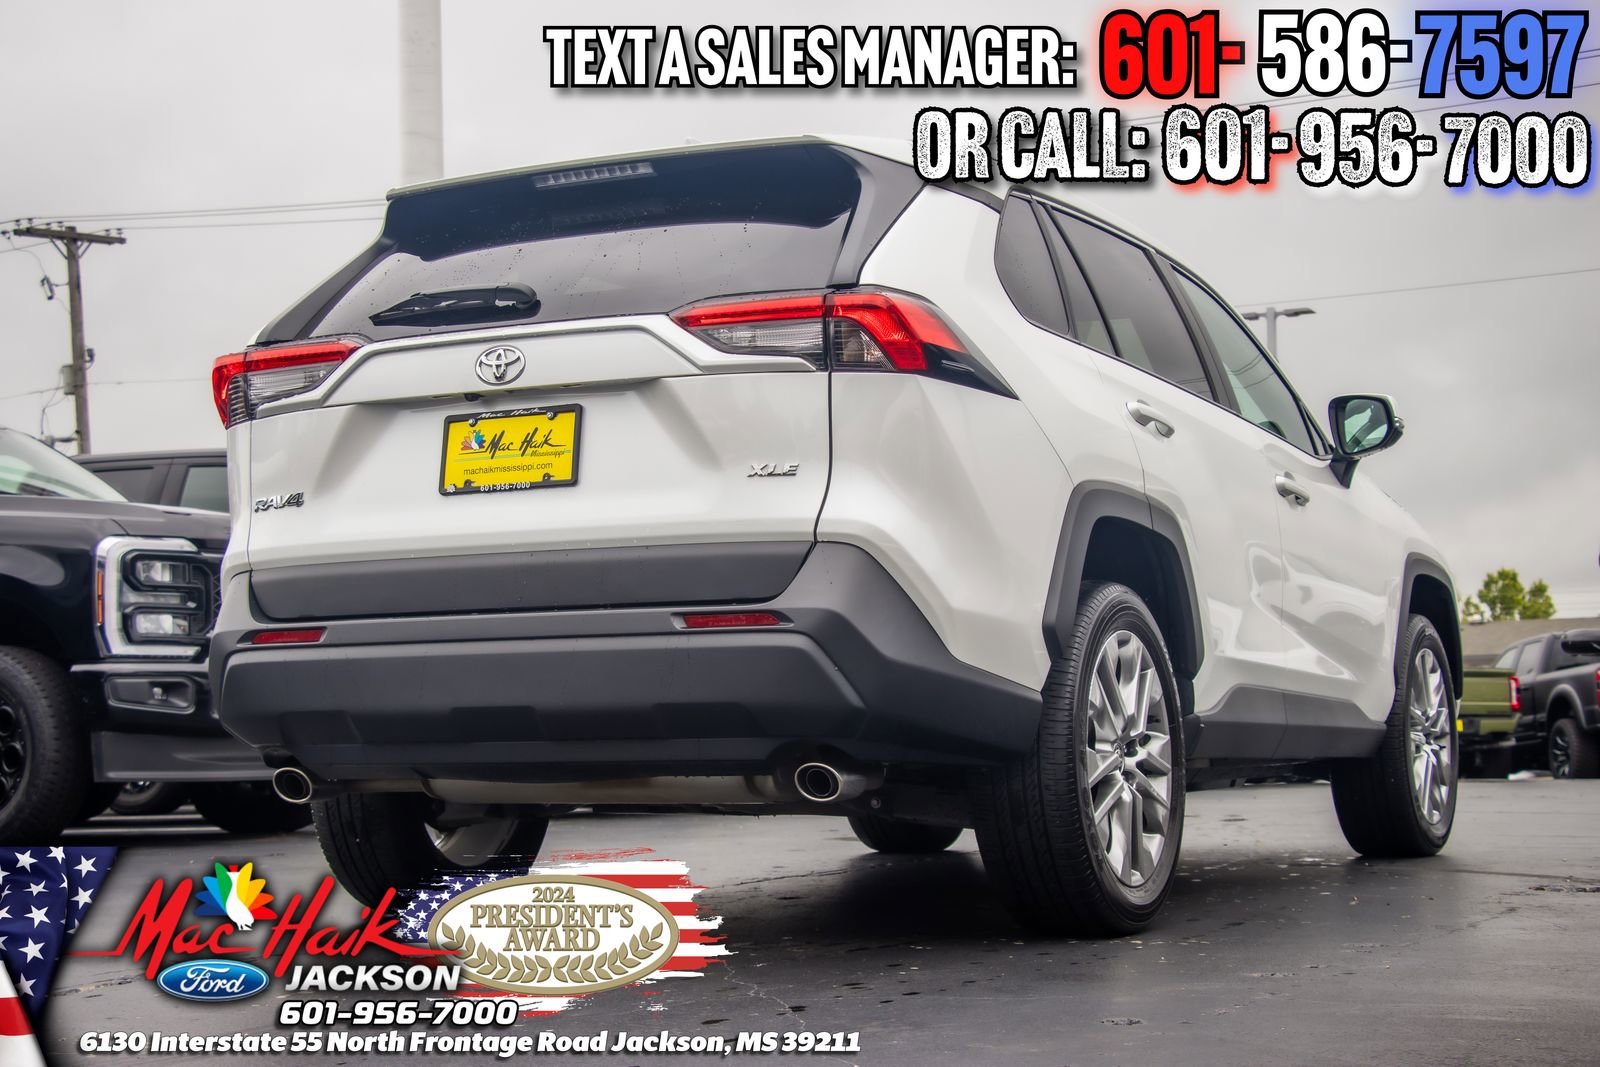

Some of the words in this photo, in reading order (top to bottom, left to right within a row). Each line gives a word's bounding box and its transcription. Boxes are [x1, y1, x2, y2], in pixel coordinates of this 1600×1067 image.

[467, 430, 515, 459] Mac
[519, 427, 561, 457] Haik
[530, 448, 566, 459] Mississippi
[463, 462, 553, 475] machaikmississippi.com
[747, 463, 799, 477] XLE
[480, 482, 531, 492] 601-956-7000
[254, 491, 304, 512] RAV4
